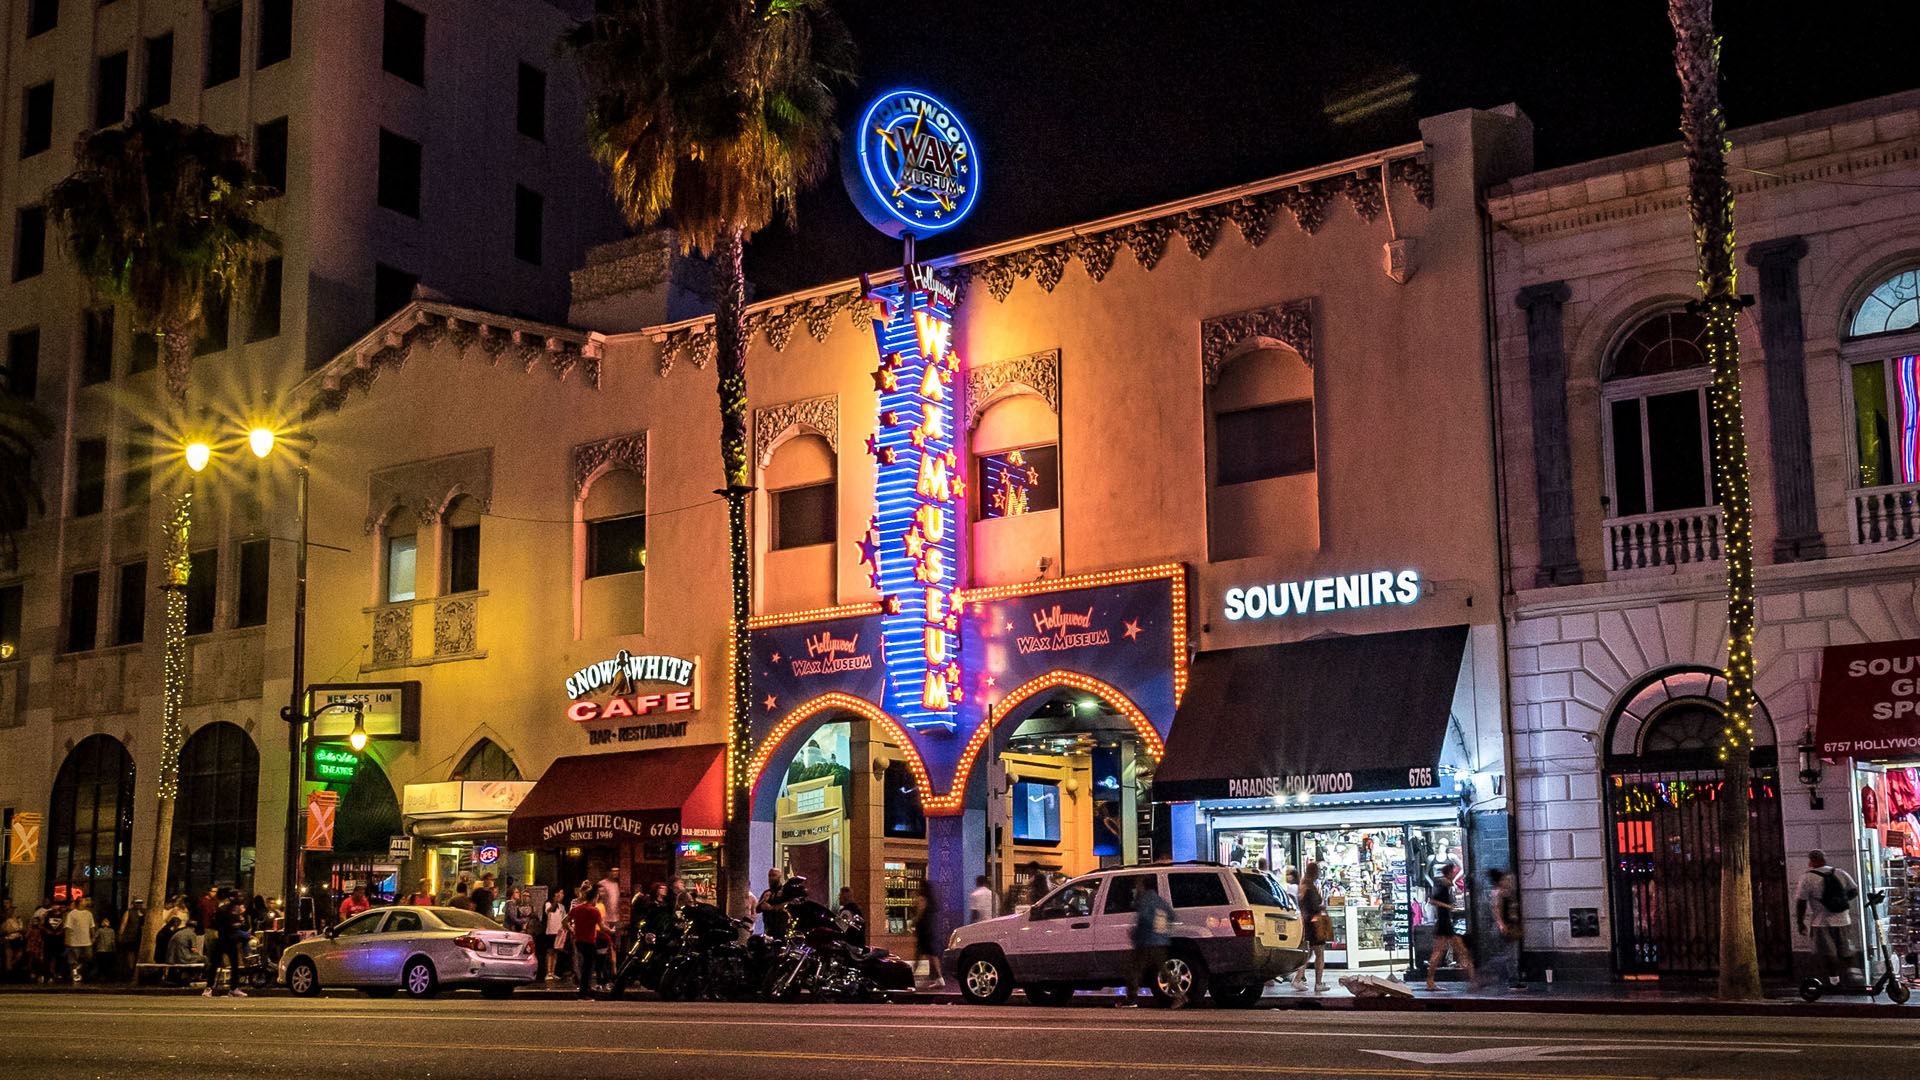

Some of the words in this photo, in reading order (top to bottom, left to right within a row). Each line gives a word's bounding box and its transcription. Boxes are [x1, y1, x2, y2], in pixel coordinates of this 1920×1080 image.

[870, 97, 967, 155] HOLLYWOOD
[895, 127, 959, 177] WAX
[903, 168, 959, 196] MUSEUM
[911, 263, 957, 304] Hollywood
[915, 311, 950, 440] WAX
[917, 452, 951, 711] MUSEUM
[1224, 570, 1419, 621] SOUVENIRS
[1033, 606, 1093, 634] Hollywood
[806, 632, 857, 660] Hollywood
[1018, 636, 1051, 655] WAX
[1053, 629, 1110, 651] MUSEUM
[566, 659, 620, 700] SNOW
[628, 655, 695, 686] WHITE
[792, 659, 821, 676] WAX
[823, 653, 872, 673] MUSEUM
[327, 694, 347, 703] NEW
[567, 691, 692, 721] CAFE
[1824, 741, 1850, 752] 6757
[1229, 775, 1280, 797] PARADISE
[1286, 772, 1353, 796] HOLLYWOOD
[1408, 767, 1432, 787] 6765
[543, 816, 574, 840] SNOW
[576, 814, 612, 830] WHITE
[613, 815, 642, 836] CAFE
[650, 823, 679, 837] 6769
[570, 830, 593, 840] SINCE
